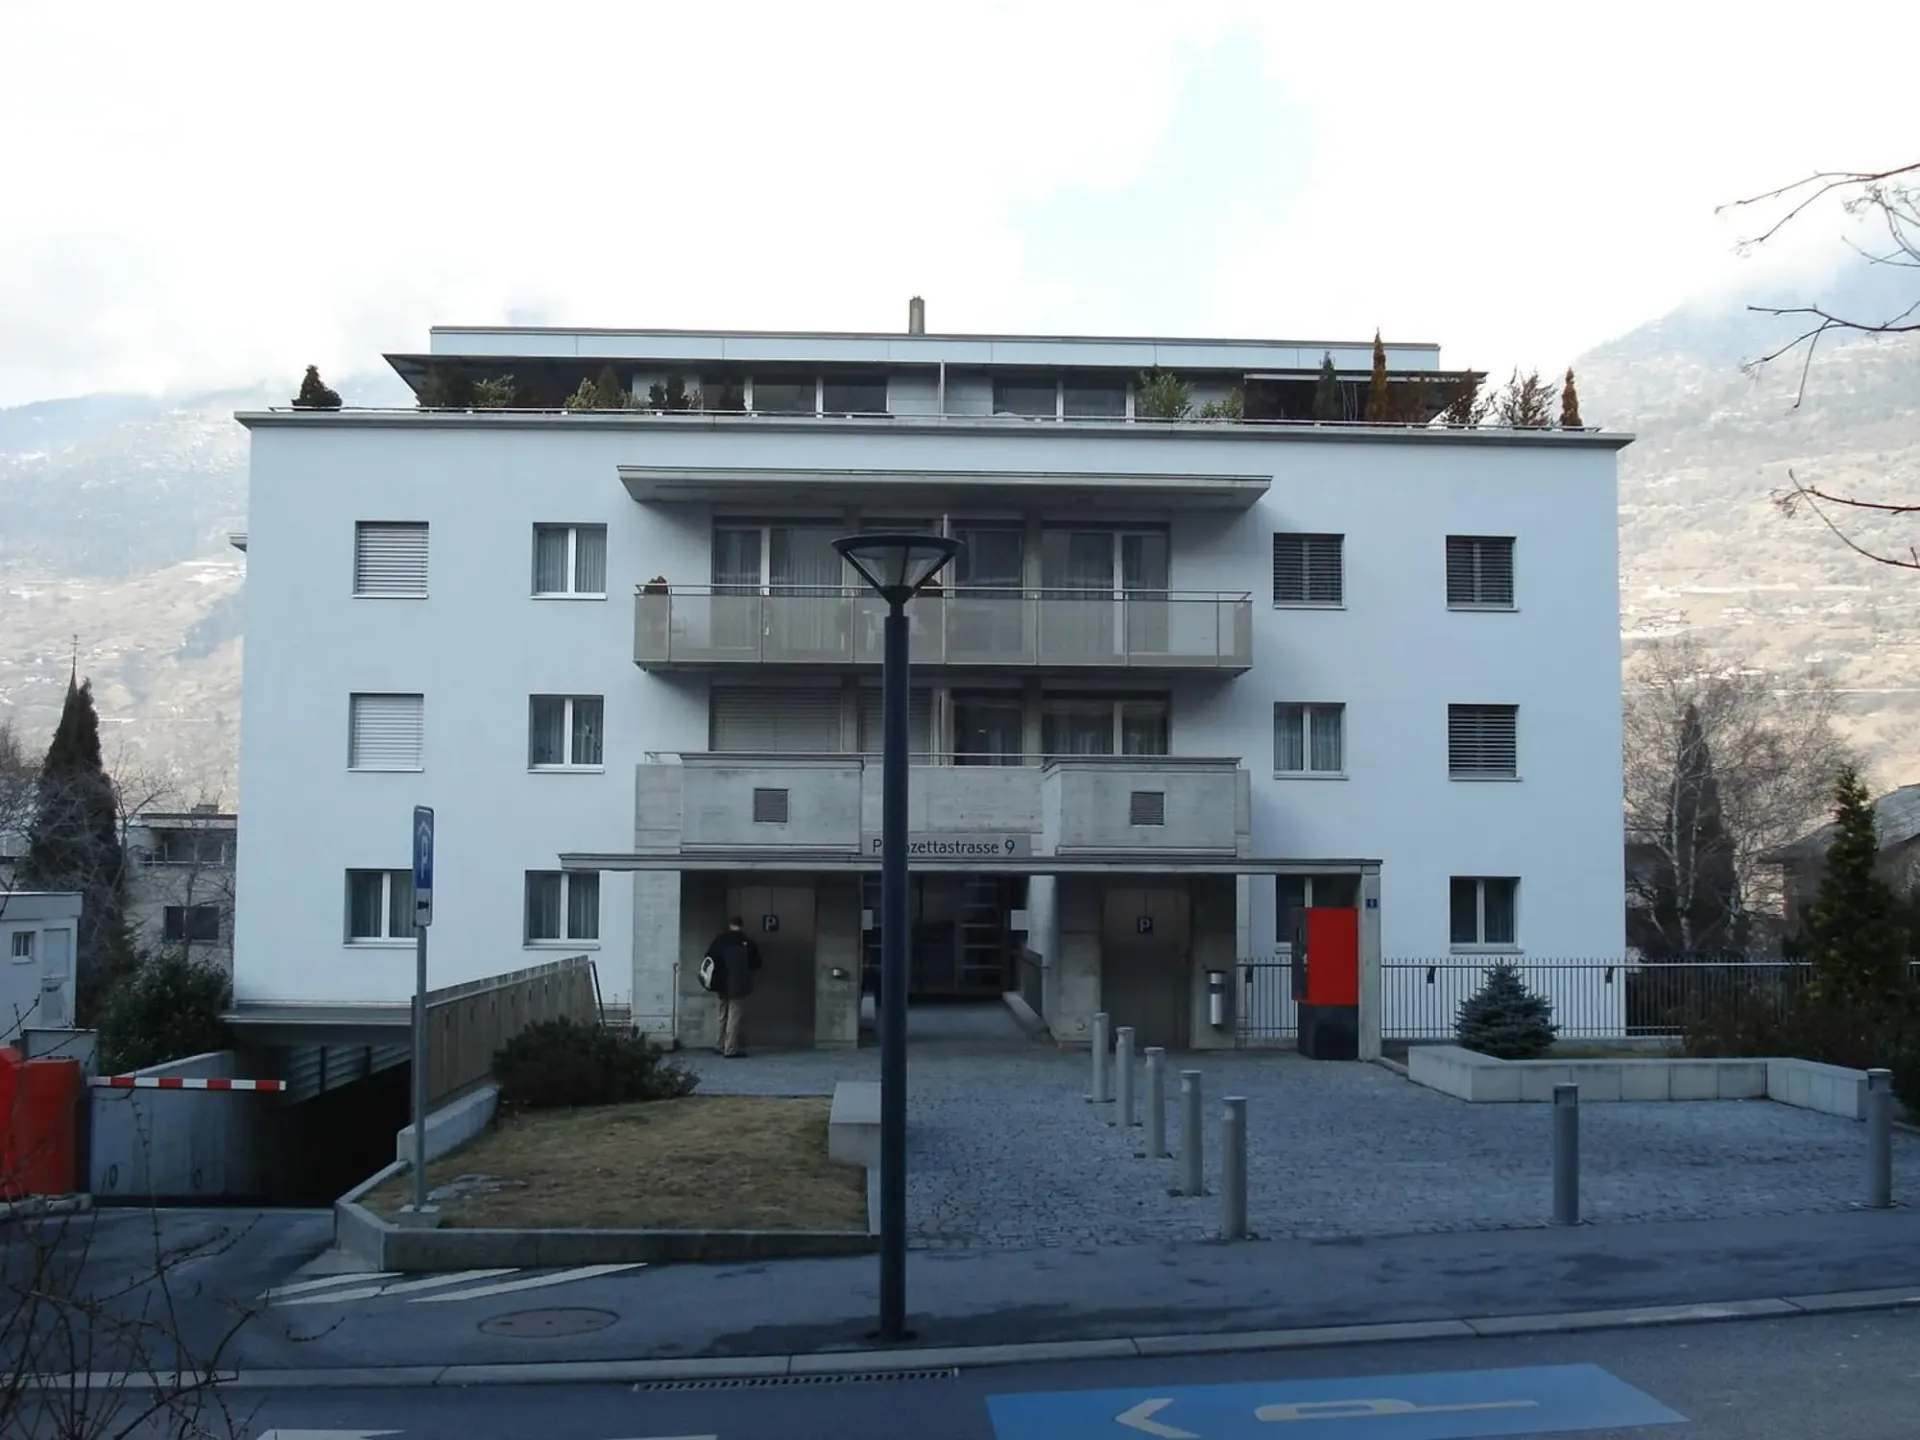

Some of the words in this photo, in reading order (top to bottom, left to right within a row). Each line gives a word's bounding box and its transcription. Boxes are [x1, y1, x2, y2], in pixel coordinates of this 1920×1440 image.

[872, 838, 999, 854] Pzettastrasse
[1004, 839, 1016, 855] 9
[421, 836, 429, 880] P
[765, 916, 777, 931] P
[1140, 918, 1151, 932] P
